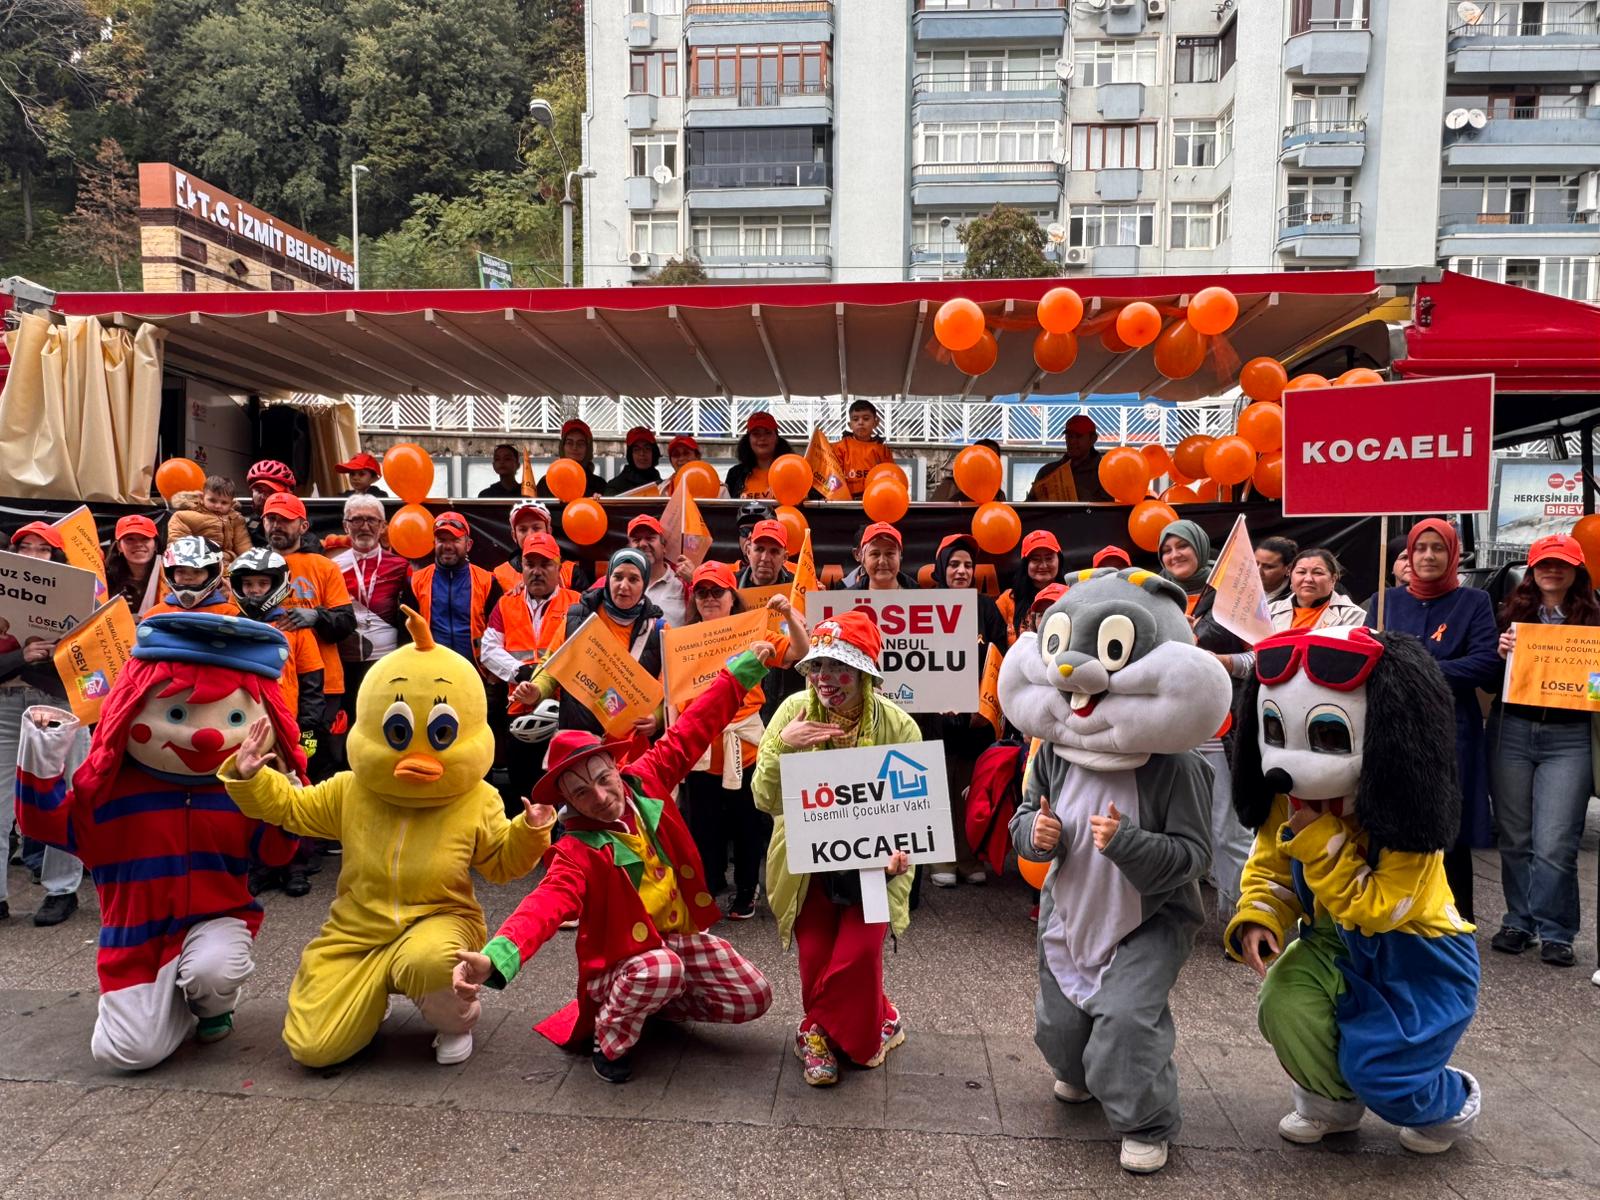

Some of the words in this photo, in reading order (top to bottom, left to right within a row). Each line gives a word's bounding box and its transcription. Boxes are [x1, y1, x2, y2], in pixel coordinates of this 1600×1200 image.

[197, 190, 236, 230] T.C.
[237, 202, 285, 251] İZMİT
[285, 233, 354, 285] BELEDİYES
[1302, 427, 1473, 464] KOCAELİ
[1513, 493, 1563, 503] HERKESİN
[1563, 493, 1580, 503] BİR
[23, 571, 57, 587] Seni
[70, 640, 89, 672] LÖSEV
[876, 651, 966, 672] DOLU
[575, 670, 602, 694] LÖSEV
[1540, 680, 1585, 692] LÖSEV
[801, 781, 886, 810] LÖSEV
[803, 809, 849, 823] Lösemili
[852, 803, 900, 820] Çocuklar
[904, 799, 931, 812] Vakfı
[811, 825, 936, 864] KOCAELİ
